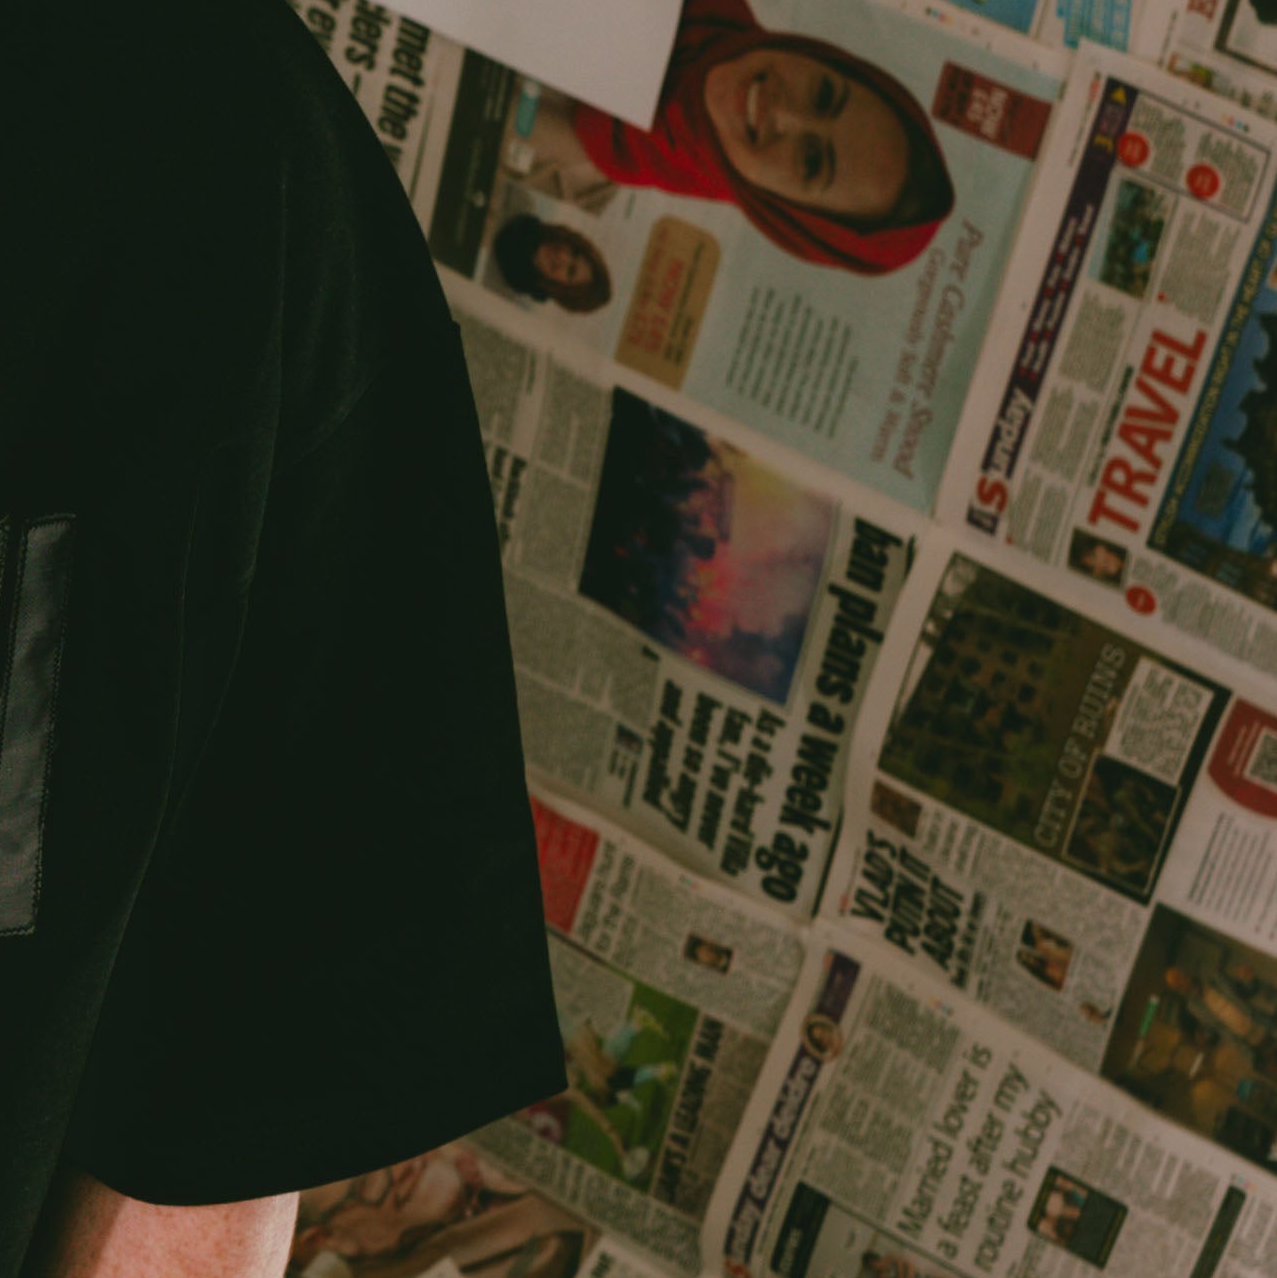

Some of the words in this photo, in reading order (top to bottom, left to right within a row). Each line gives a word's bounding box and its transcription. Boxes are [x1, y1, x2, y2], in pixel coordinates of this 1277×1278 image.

[1089, 331, 1205, 530] TRAVEL
[845, 518, 902, 592] ban
[815, 584, 883, 703] plans
[1071, 643, 1125, 738] RUINS
[780, 734, 838, 833] week
[1057, 737, 1088, 779] OF
[1033, 778, 1073, 847] CITY
[755, 831, 809, 903] ago
[920, 882, 962, 970] ABOUT
[896, 1137, 953, 1239] Married
[934, 1068, 979, 1139] lover
[938, 1173, 983, 1238] feast
[968, 1111, 1004, 1176] after
[992, 1062, 1030, 1112] my
